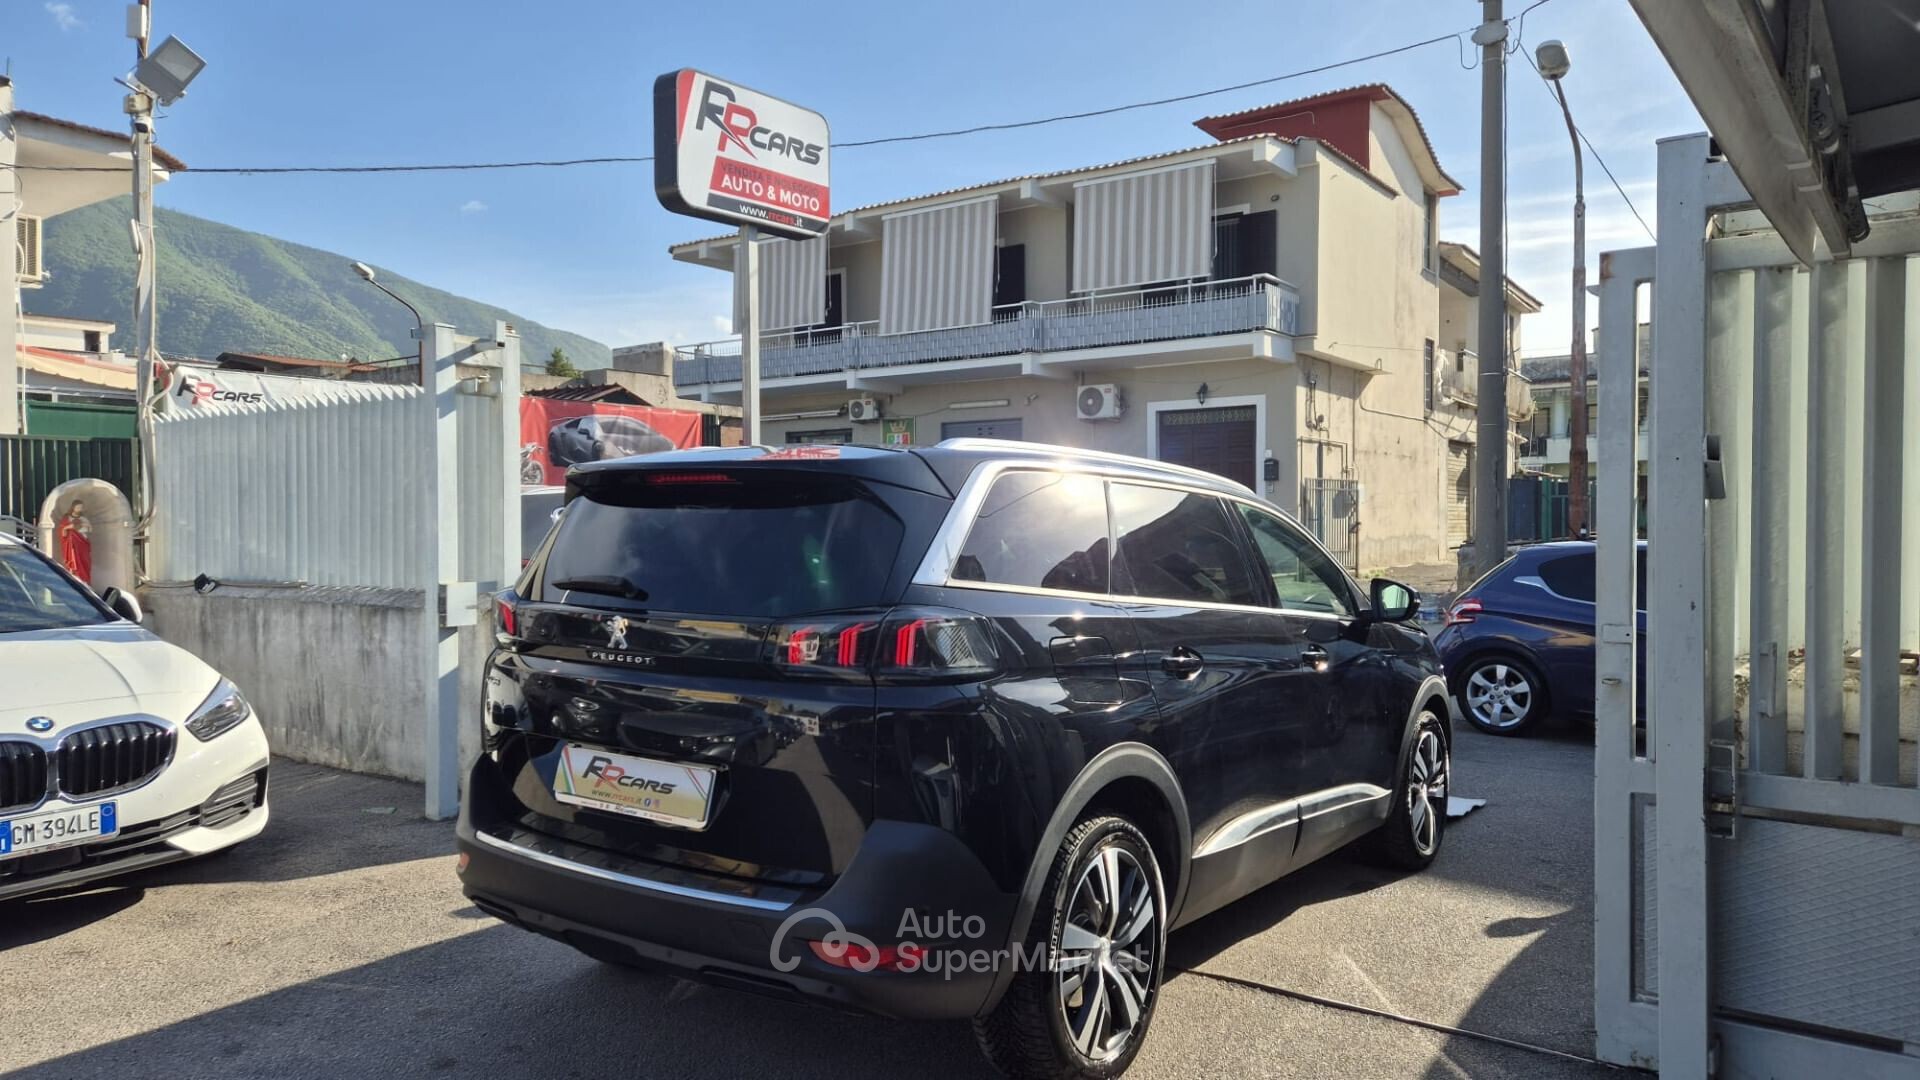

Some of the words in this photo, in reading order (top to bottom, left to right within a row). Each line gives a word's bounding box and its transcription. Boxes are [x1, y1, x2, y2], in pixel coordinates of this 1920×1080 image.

[721, 161, 763, 181] VENDITA
[721, 174, 763, 196] AUTO
[767, 186, 777, 200] &
[780, 188, 820, 212] MOTO
[739, 203, 804, 228] www.rrcars.it
[592, 651, 653, 665] PEUGEOT
